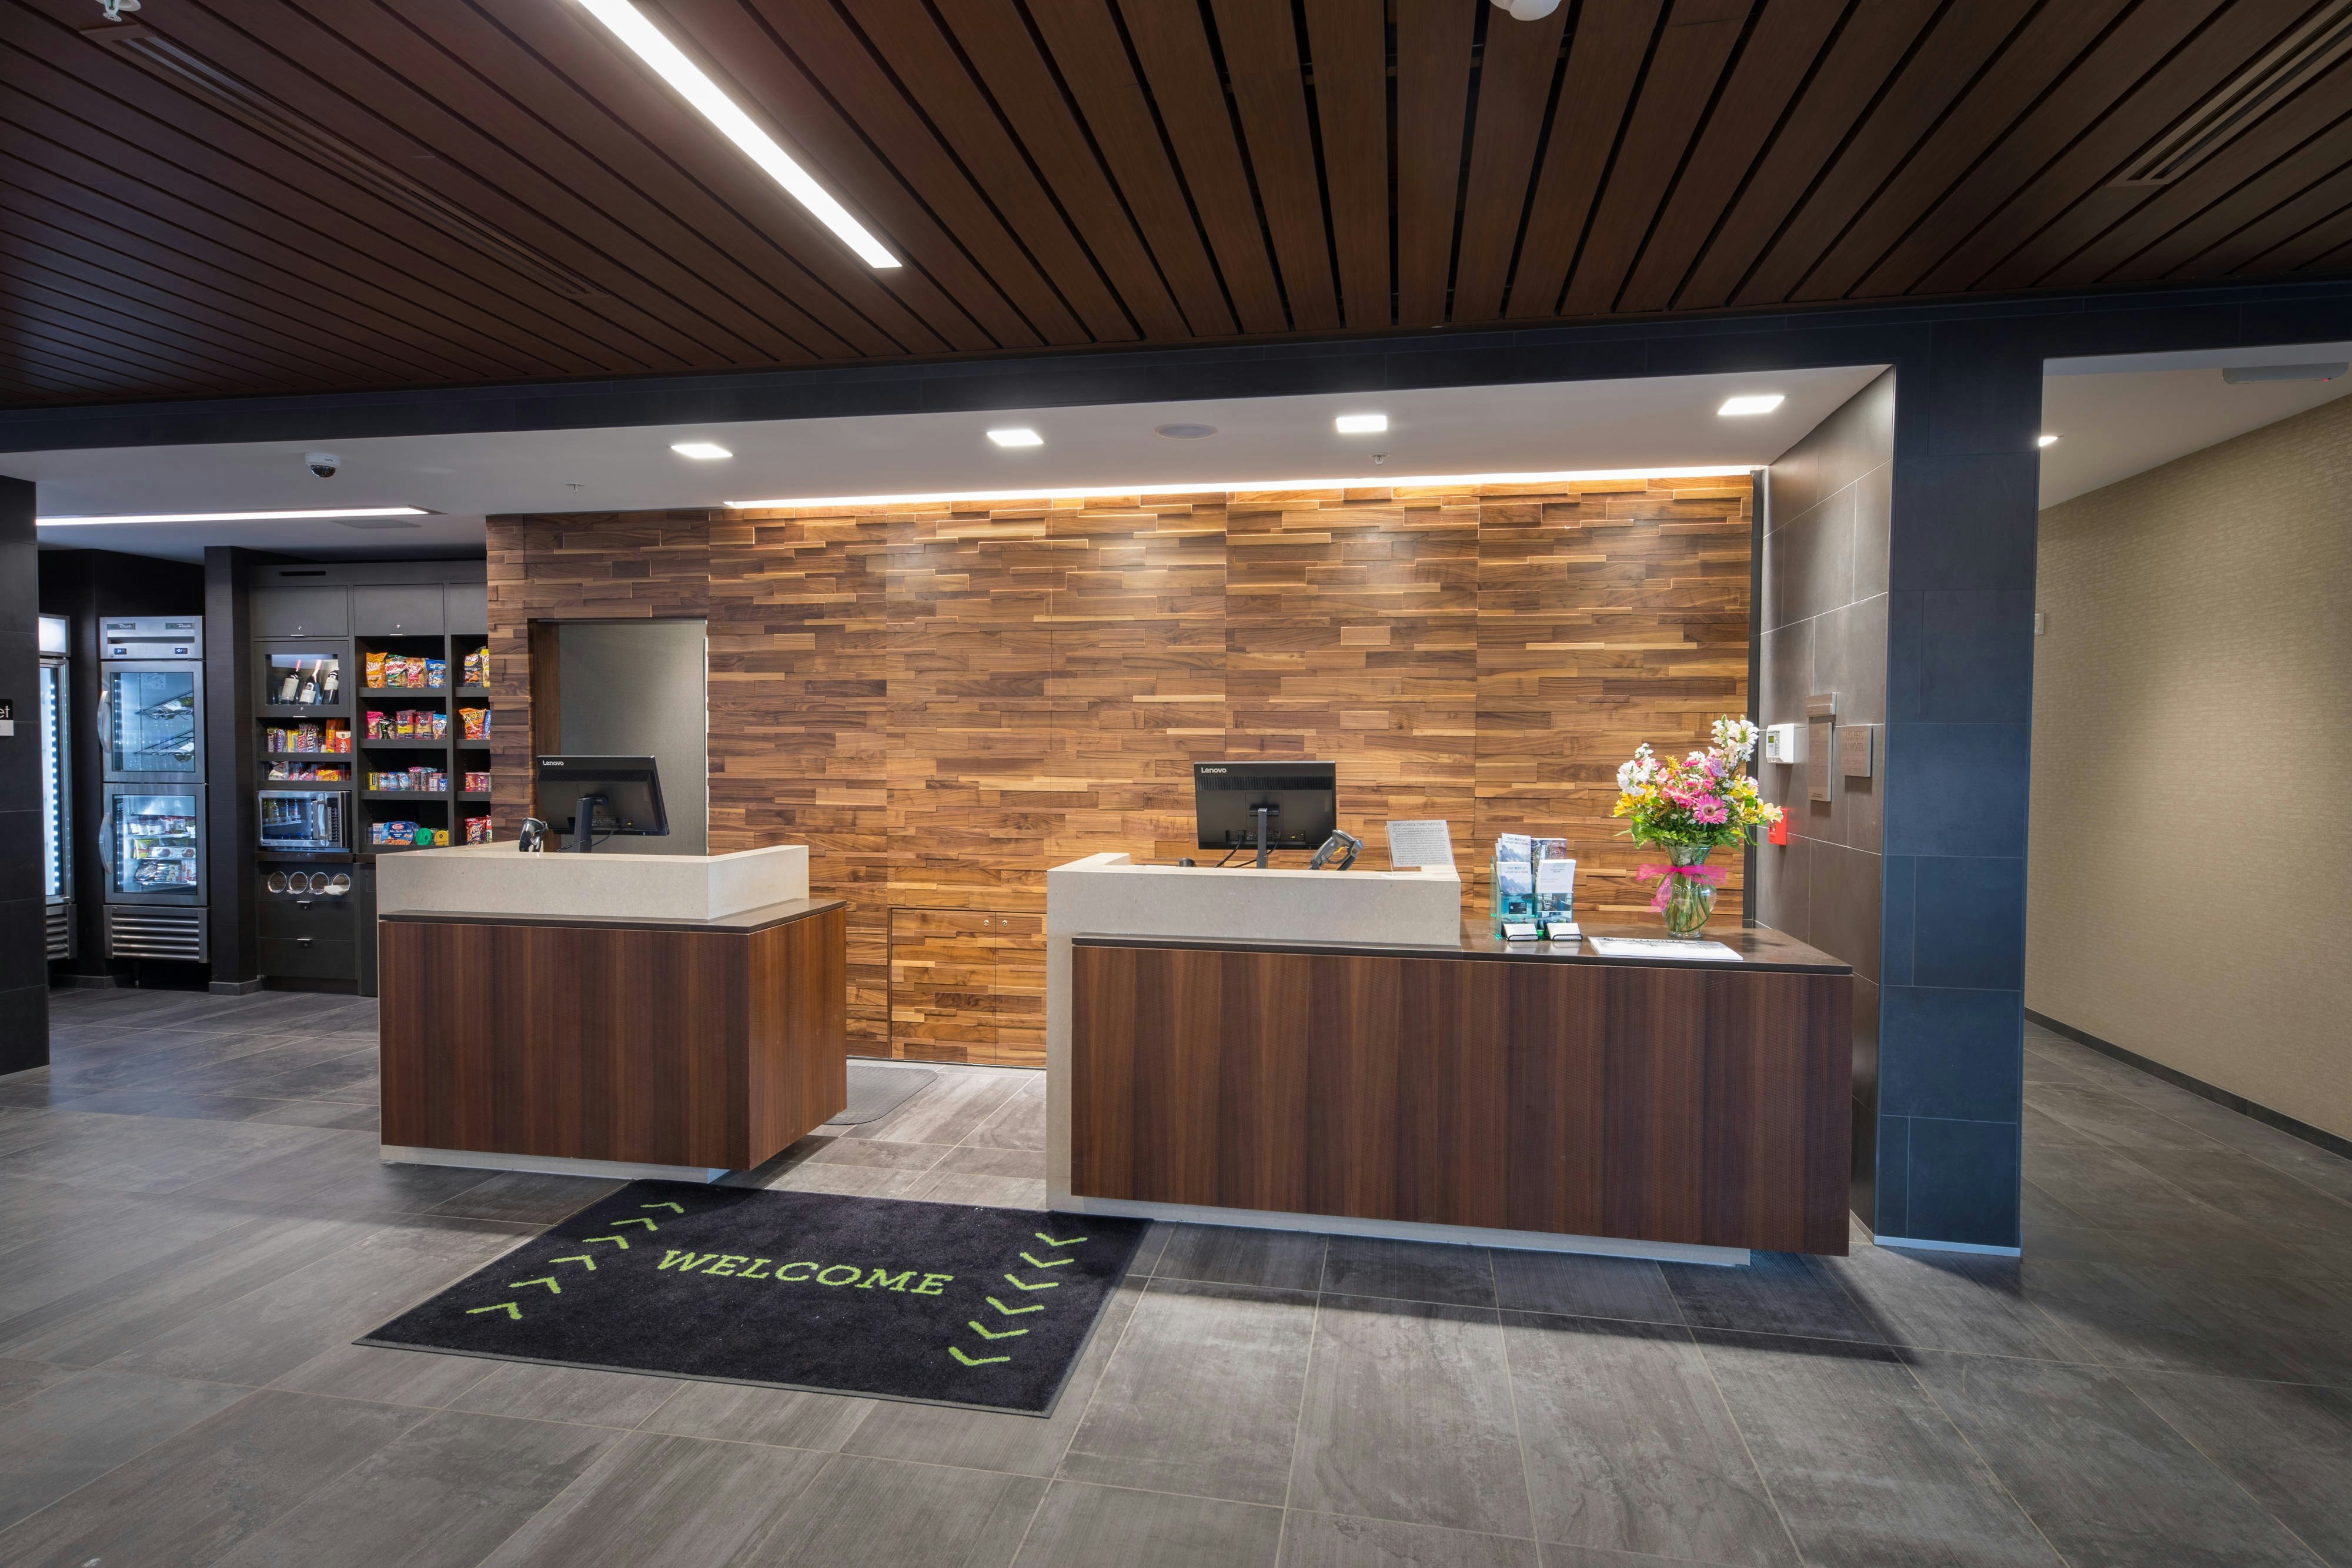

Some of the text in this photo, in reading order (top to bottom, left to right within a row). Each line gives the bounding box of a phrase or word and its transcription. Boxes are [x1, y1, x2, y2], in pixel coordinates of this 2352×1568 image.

[1853, 730, 1863, 740] PETS
[1852, 742, 1864, 752] HOTEL
[657, 1249, 954, 1295] WELCOME
